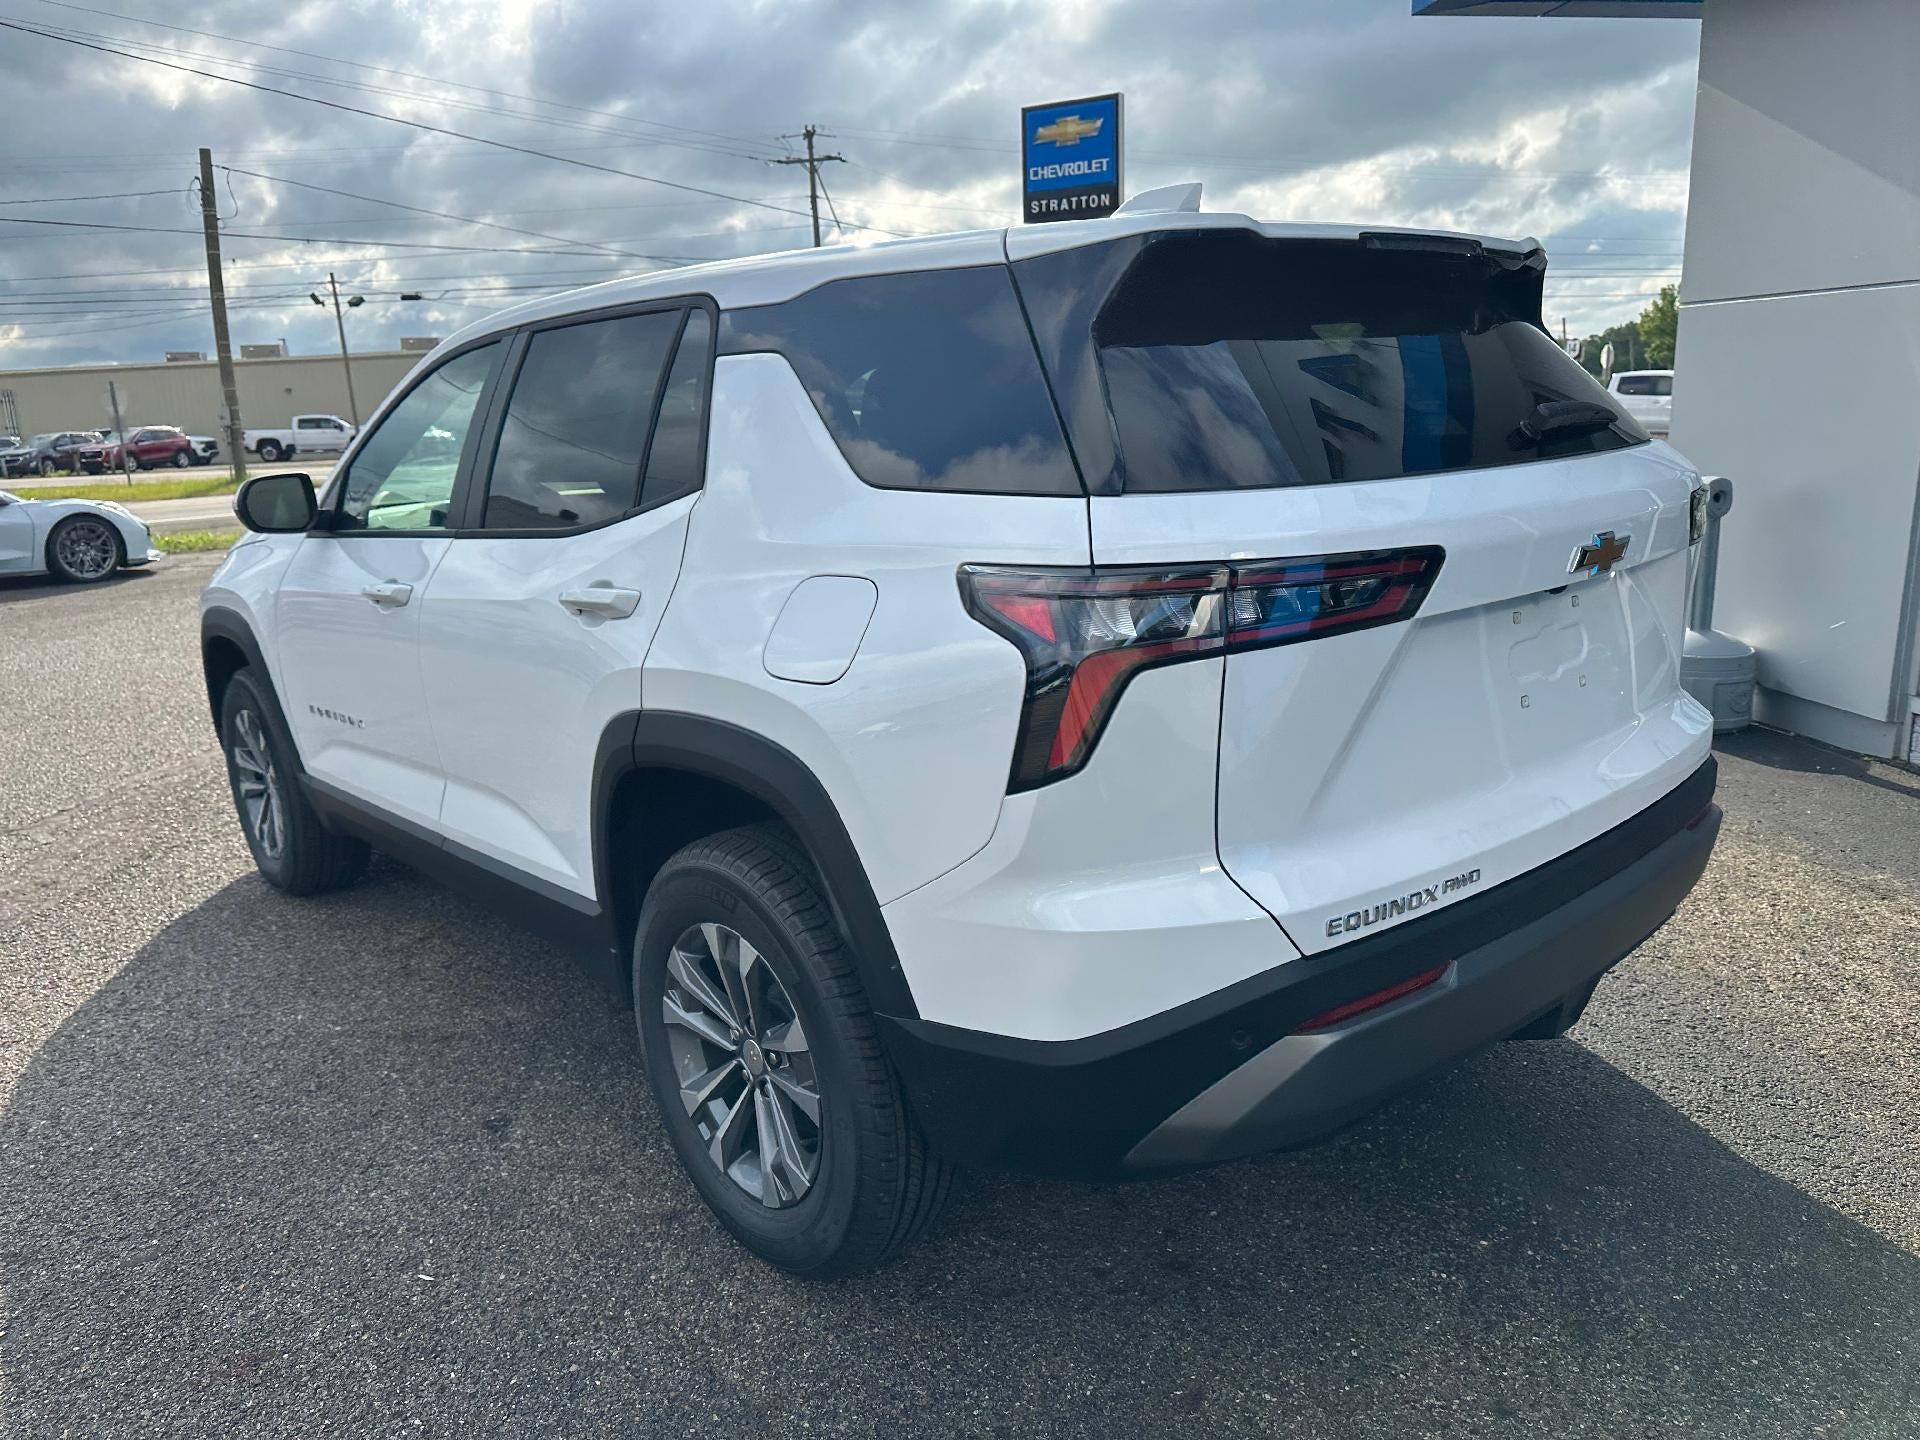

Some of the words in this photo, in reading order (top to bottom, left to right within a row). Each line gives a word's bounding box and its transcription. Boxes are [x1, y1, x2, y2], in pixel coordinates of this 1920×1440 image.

[1030, 158, 1110, 181] CHEVROLET
[1031, 194, 1111, 213] STRATTON
[1325, 885, 1439, 937] EQUINOX
